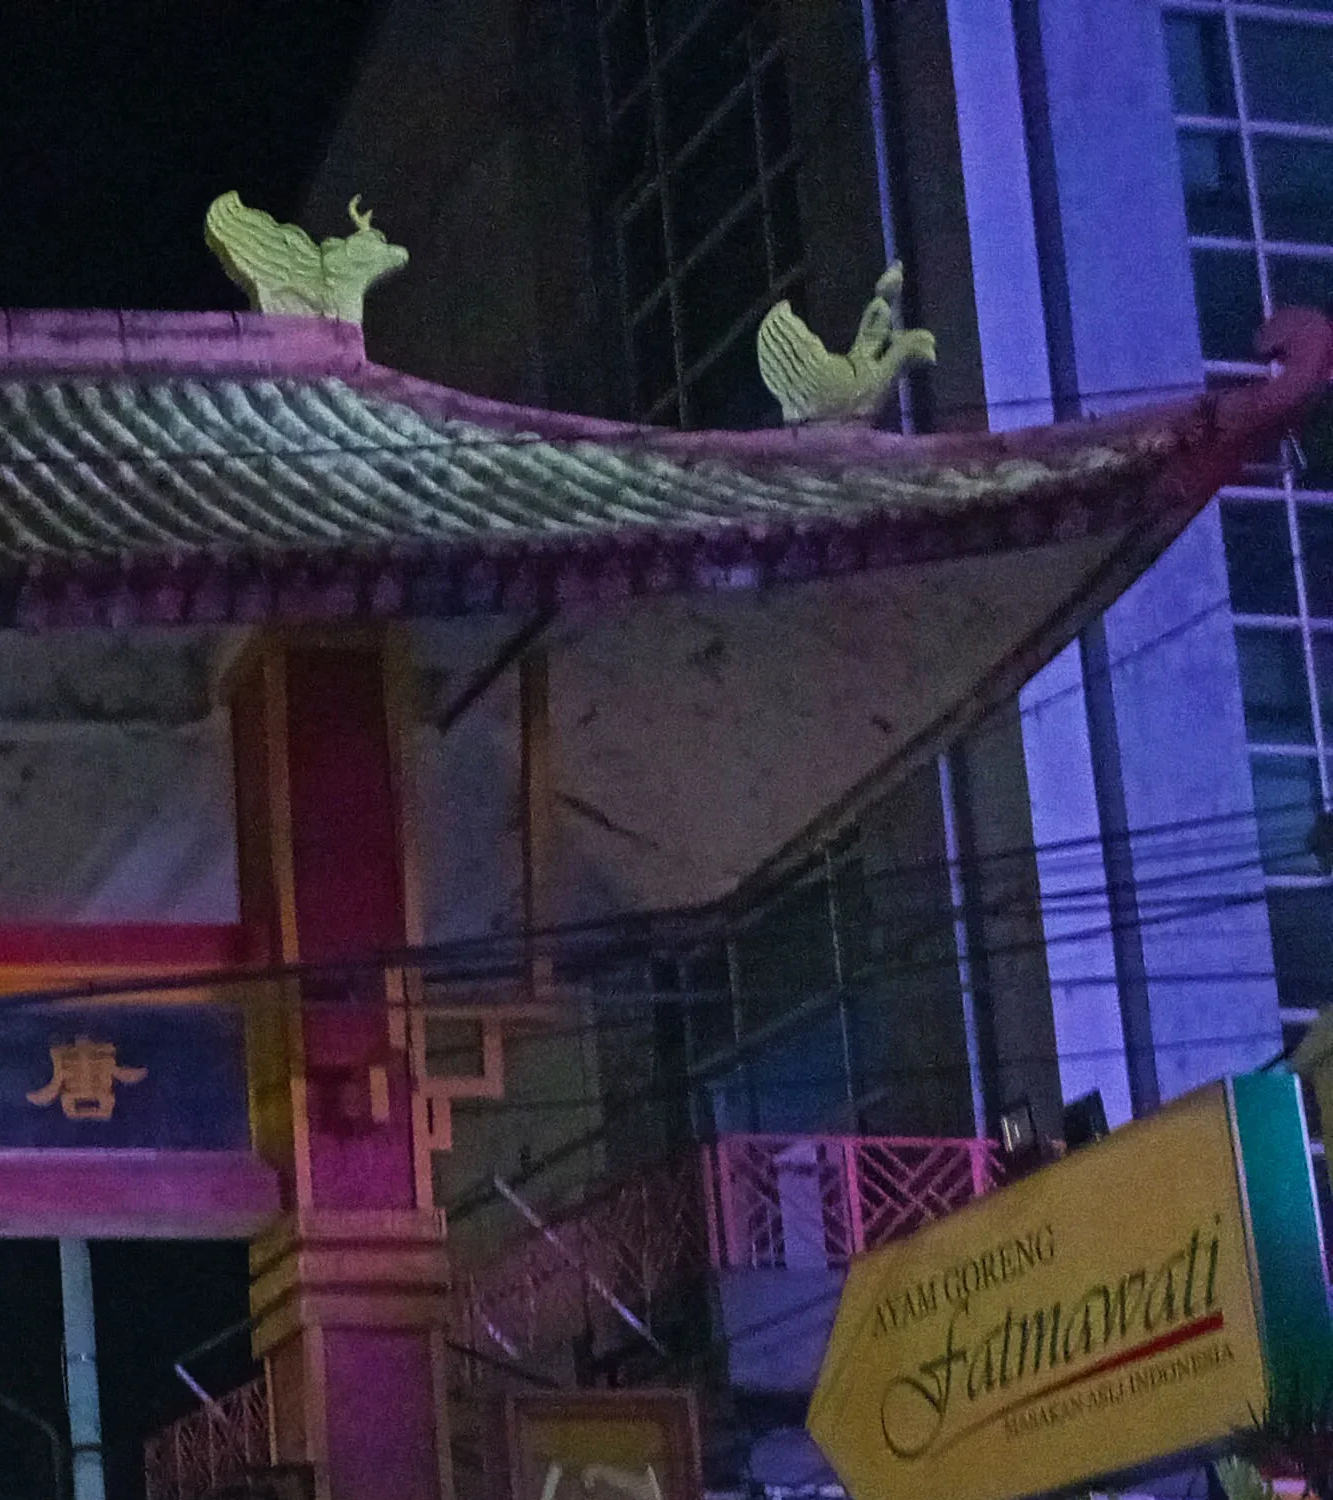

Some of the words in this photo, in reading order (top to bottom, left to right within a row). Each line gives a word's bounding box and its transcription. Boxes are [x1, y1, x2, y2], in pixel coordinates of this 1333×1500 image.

[872, 1276, 938, 1340] AYAM
[943, 1222, 1055, 1304] GORENG
[881, 1213, 1223, 1459] Fatmawati
